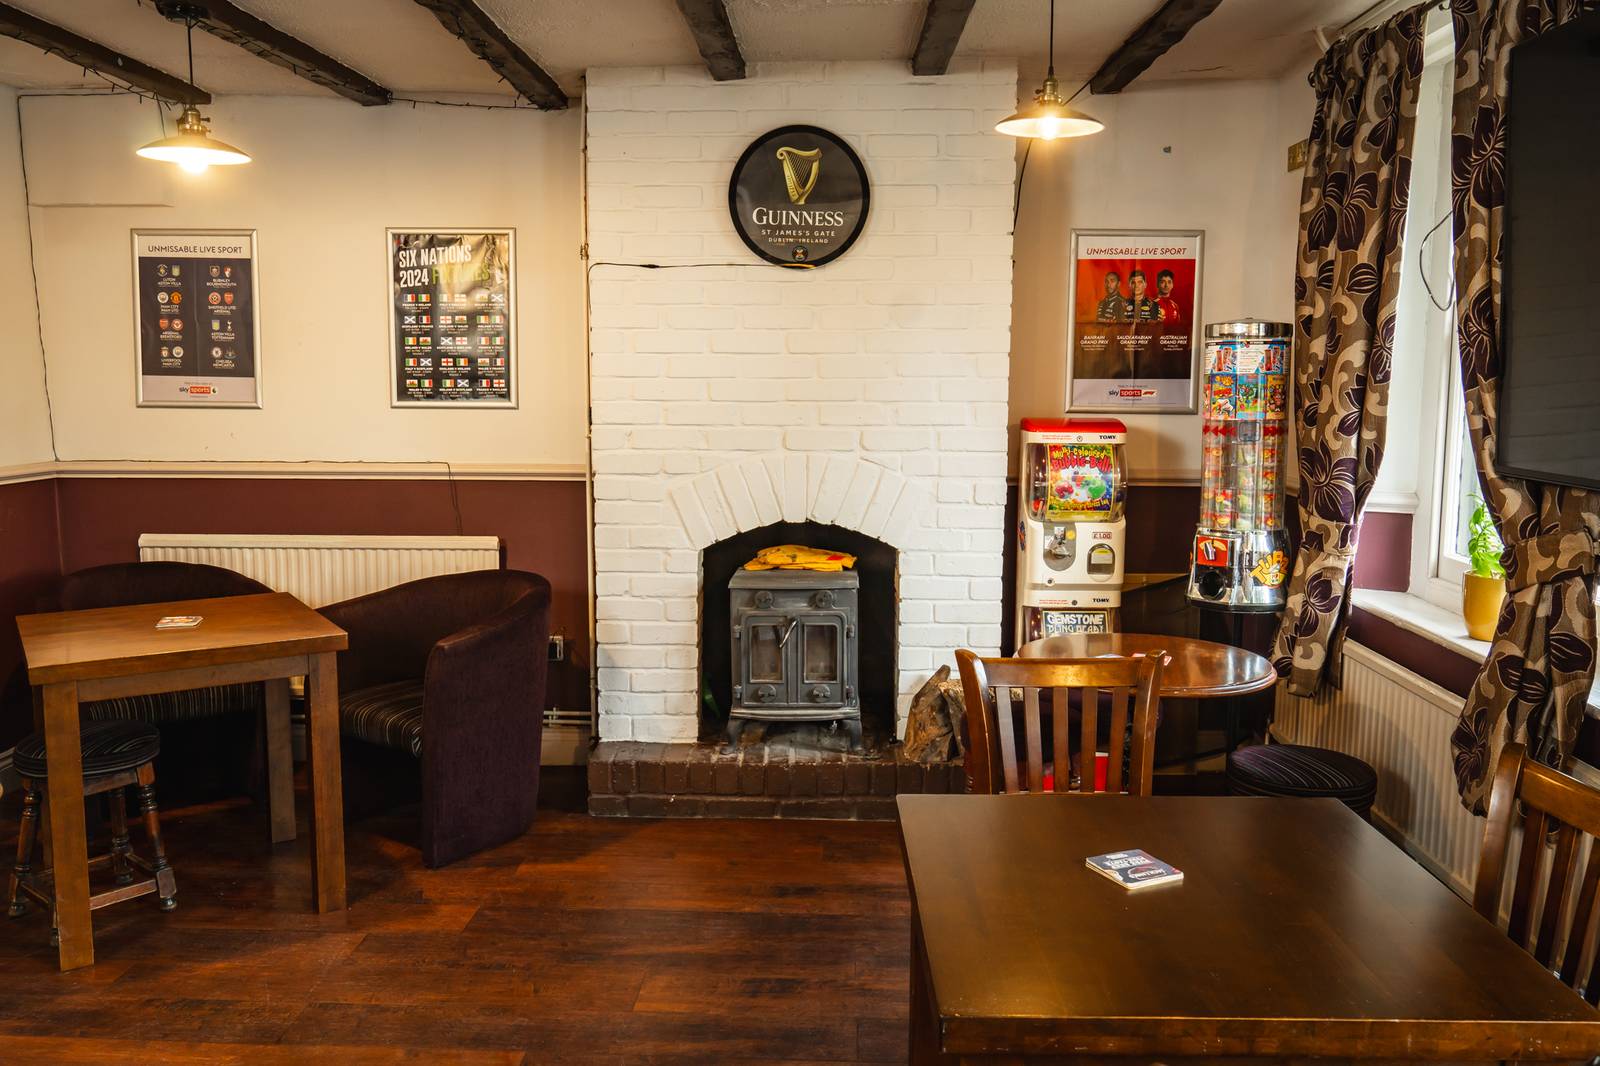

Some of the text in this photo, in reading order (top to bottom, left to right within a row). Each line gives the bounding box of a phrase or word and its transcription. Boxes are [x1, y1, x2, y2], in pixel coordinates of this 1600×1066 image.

[752, 206, 844, 227] GUINNESS
[148, 245, 243, 254] UNMISSABLE LIVE SPORT
[1086, 247, 1187, 256] UNMISSABLE LIVE SPORT
[399, 244, 472, 268] SIX NATIONS
[400, 268, 429, 288] 2024
[179, 386, 189, 394] sky
[1047, 613, 1104, 624] GEMSTONE
